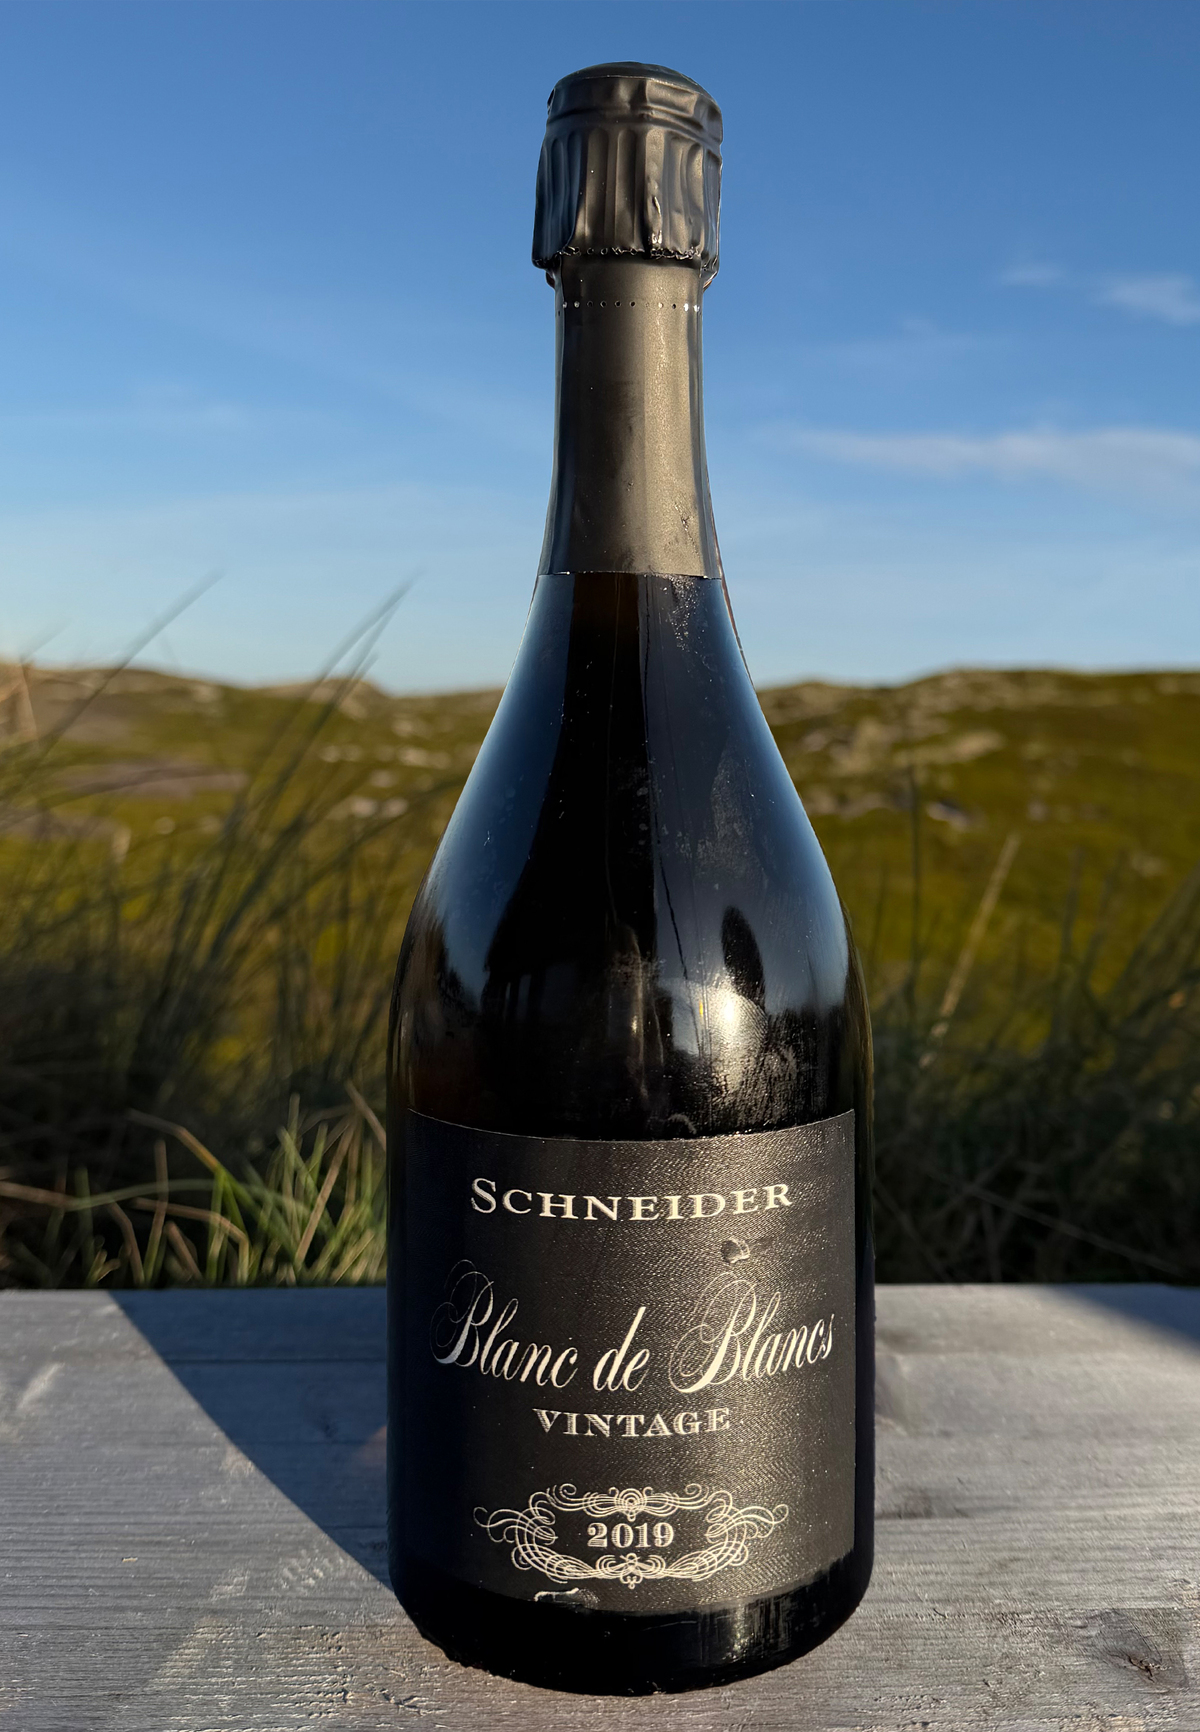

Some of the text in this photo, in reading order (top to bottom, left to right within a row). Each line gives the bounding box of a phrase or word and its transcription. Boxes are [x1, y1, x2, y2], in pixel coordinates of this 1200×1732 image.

[471, 1177, 793, 1222] SCHNEIDER
[429, 1259, 835, 1395] Blanc de Blancs
[532, 1407, 732, 1438] VINTAGE
[586, 1521, 676, 1549] 2019
